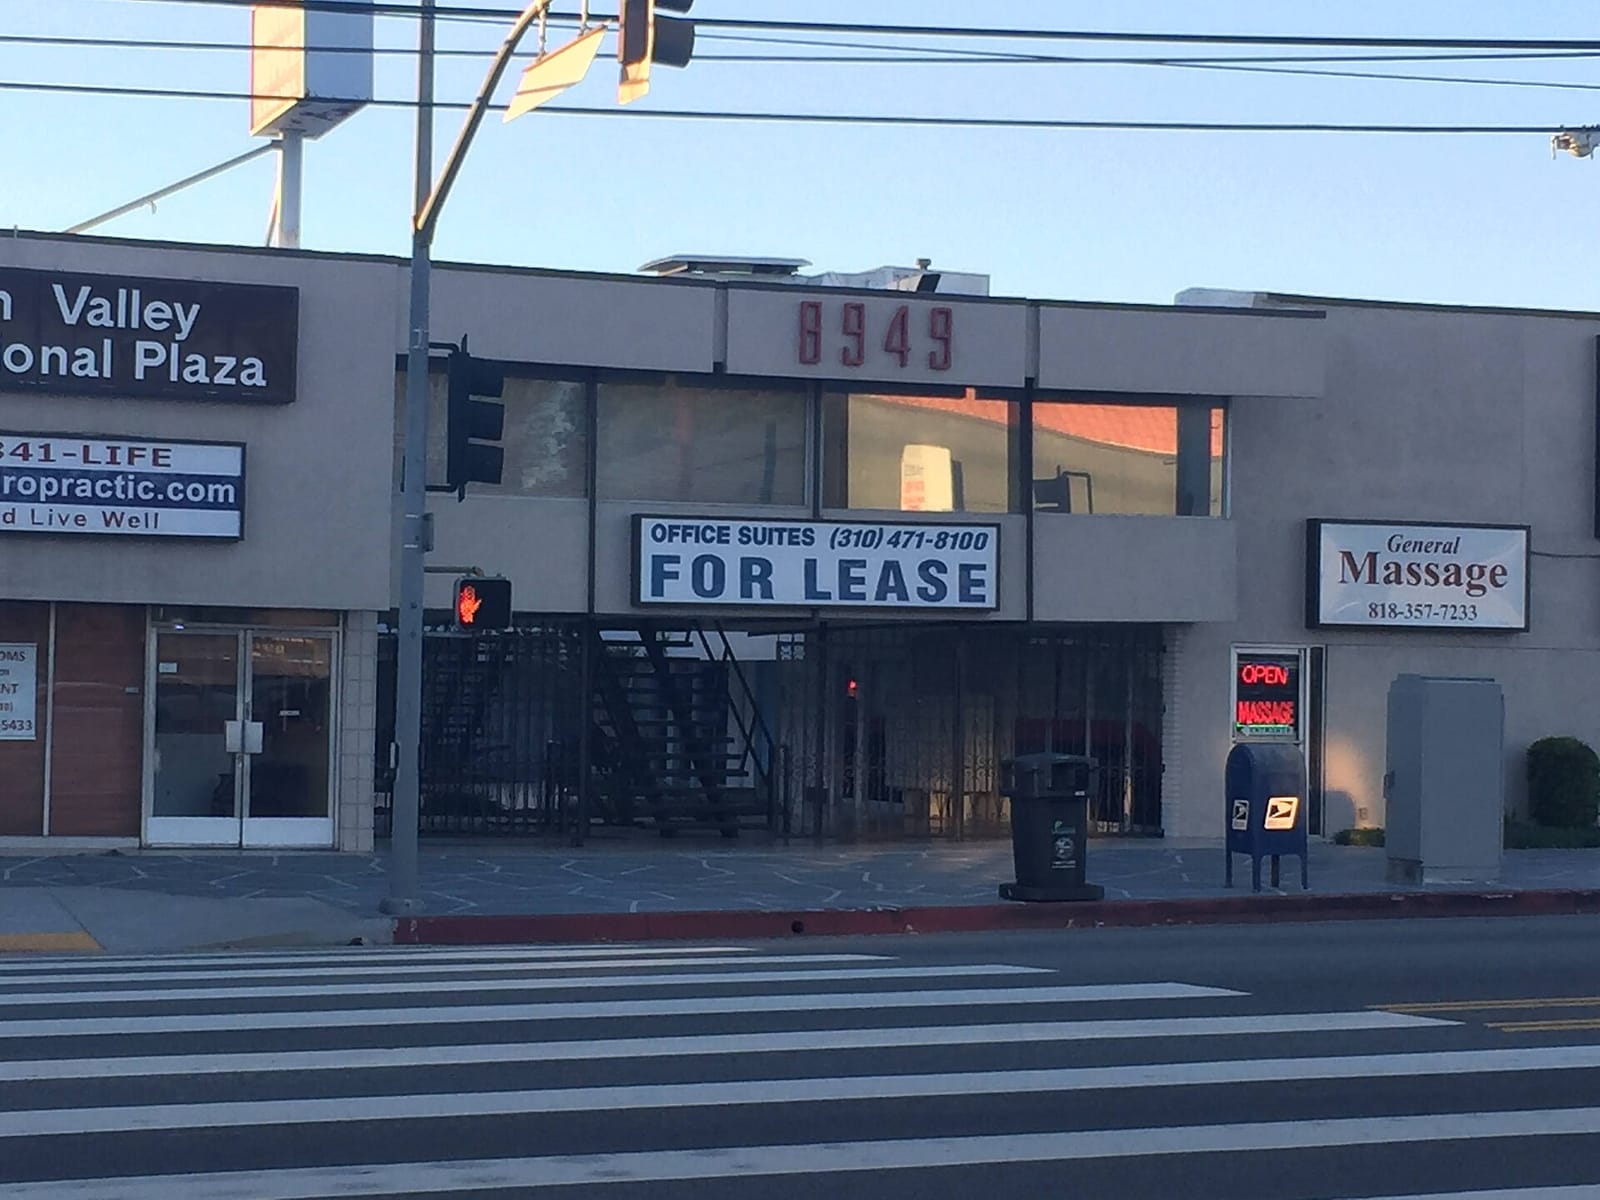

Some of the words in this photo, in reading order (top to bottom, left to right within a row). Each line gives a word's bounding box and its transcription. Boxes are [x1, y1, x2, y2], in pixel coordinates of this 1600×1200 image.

[52, 284, 200, 340] Valley
[799, 301, 953, 371] 8949
[3, 339, 112, 378] onal
[135, 340, 267, 387] Plaza
[0, 442, 172, 468] 41-LIFE
[3, 475, 235, 504] ropractic.com
[30, 508, 88, 527] Live
[102, 510, 160, 530] Well
[651, 523, 731, 545] OFFICE
[737, 525, 816, 547] SUITES
[829, 526, 884, 550] (310)
[886, 529, 989, 551] 471-8100
[1387, 533, 1461, 555] General
[650, 553, 774, 601] FOR
[803, 557, 987, 603] LEASE
[1338, 550, 1508, 597] Massage
[1368, 602, 1478, 621] 818-357-7233
[0, 683, 19, 694] NT
[1242, 665, 1288, 685] OPEN
[1238, 701, 1295, 725] MASSAGE
